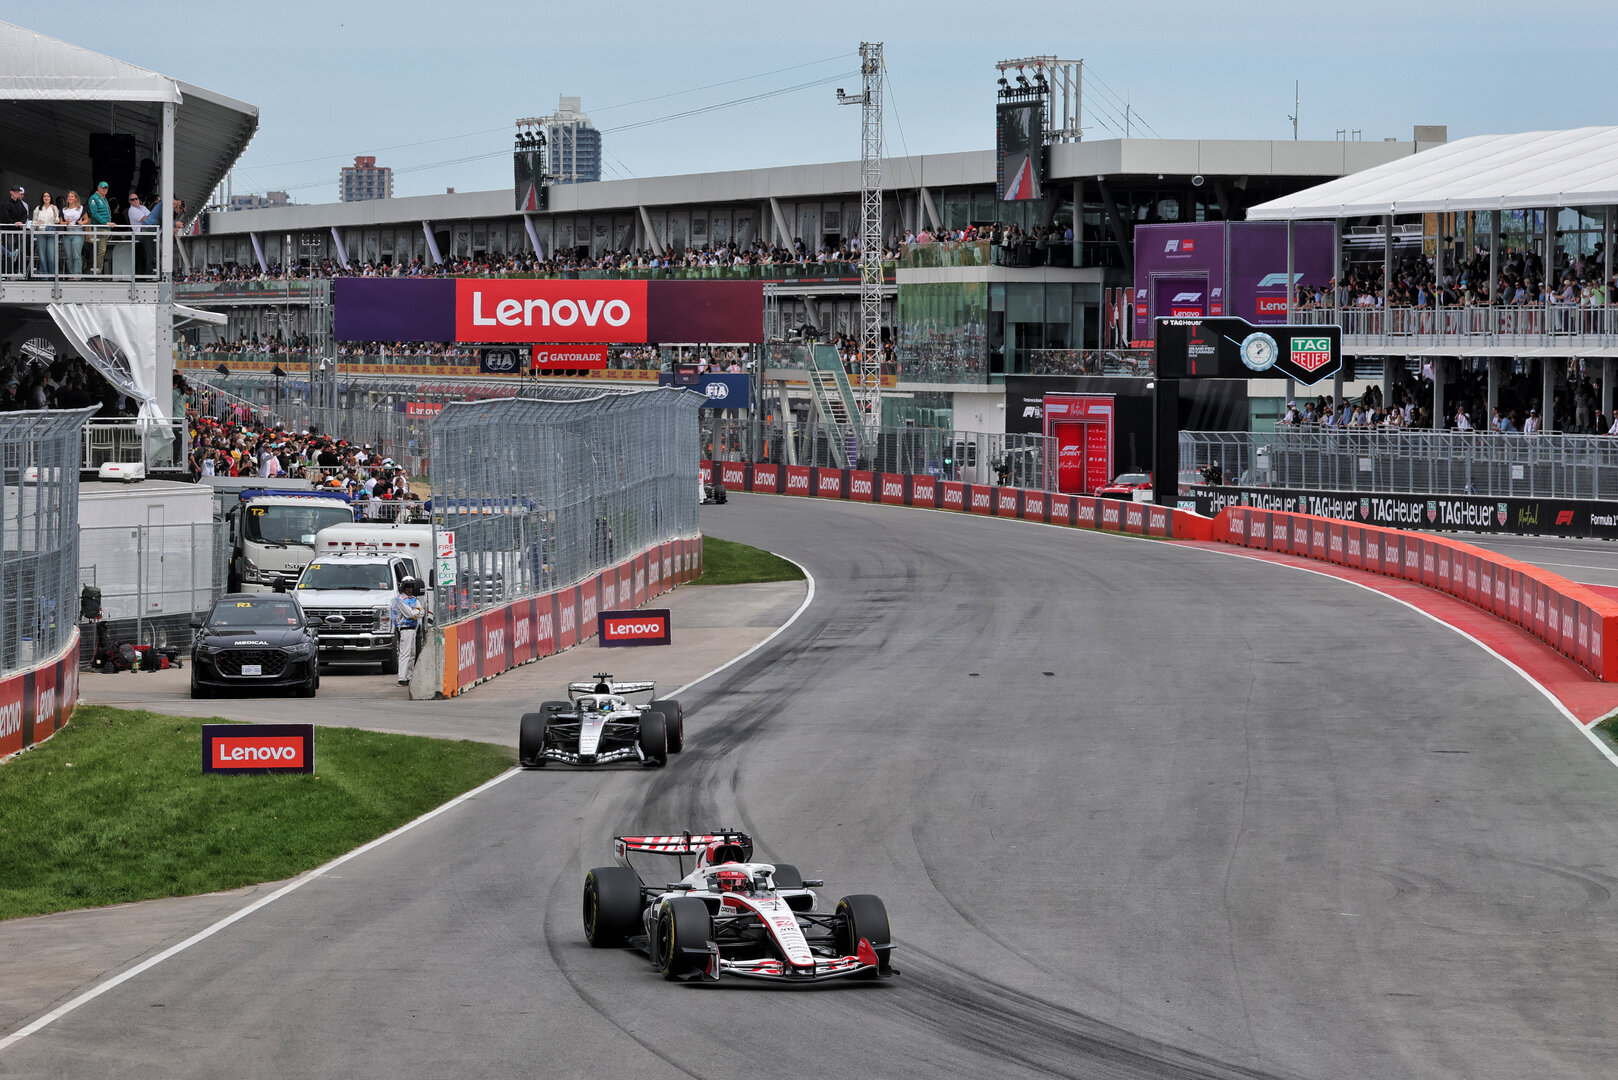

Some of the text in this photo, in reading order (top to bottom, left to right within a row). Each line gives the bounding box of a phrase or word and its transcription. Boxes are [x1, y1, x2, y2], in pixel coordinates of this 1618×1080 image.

[473, 292, 630, 326] Lenovo
[1260, 301, 1288, 310] Leno
[1294, 340, 1327, 349] TAG
[550, 353, 601, 361] GATORADE
[1293, 352, 1329, 370] HEUER
[708, 386, 726, 396] FIA
[410, 404, 440, 415] Lenovo
[723, 466, 743, 484] Lenovo
[755, 469, 775, 486] Lenovo
[788, 471, 808, 488] Lenovo
[819, 473, 839, 491] Lenovo
[851, 476, 871, 493] Lenovo
[883, 478, 902, 497] Lenovo
[914, 480, 933, 499] Lenovo
[944, 483, 962, 504] Lenovo
[972, 490, 990, 508] Lenovo
[998, 493, 1016, 510] Lenovo
[1026, 496, 1042, 514] Lenovo
[1052, 498, 1068, 518] Lenovo
[1078, 502, 1094, 520] Lenovo
[1103, 504, 1119, 524] Lenovo
[1127, 507, 1142, 526] Lenovo
[1149, 509, 1165, 528] Lenovo
[1251, 494, 1296, 512] TAGHeuer
[1309, 497, 1357, 520] TAGHeuer
[1372, 499, 1424, 524] TAGHeuer
[1439, 501, 1494, 526] TAGHeuer
[1591, 514, 1612, 526] Formula
[1229, 514, 1243, 534] Lenovo
[1251, 518, 1265, 538] Lenovo
[1273, 521, 1287, 540] Lenovo
[1295, 524, 1307, 544] Lenovo
[1313, 527, 1324, 548] Lenovo
[1330, 531, 1342, 552] Lenovo
[1348, 534, 1360, 556] Lenovo
[1367, 538, 1378, 560] Lenovo
[1386, 542, 1398, 563] Lenovo
[559, 602, 575, 634] Lenovo
[582, 593, 597, 624] Lenovo
[513, 614, 530, 648] Lenovo
[537, 608, 553, 641] Lenovo
[610, 622, 659, 635] Lenovo
[485, 626, 504, 660] Lenovo
[457, 637, 475, 672] Lenovo
[36, 686, 55, 724] Lenovo
[0, 700, 21, 738] enovo
[220, 744, 296, 761] Lenovo
